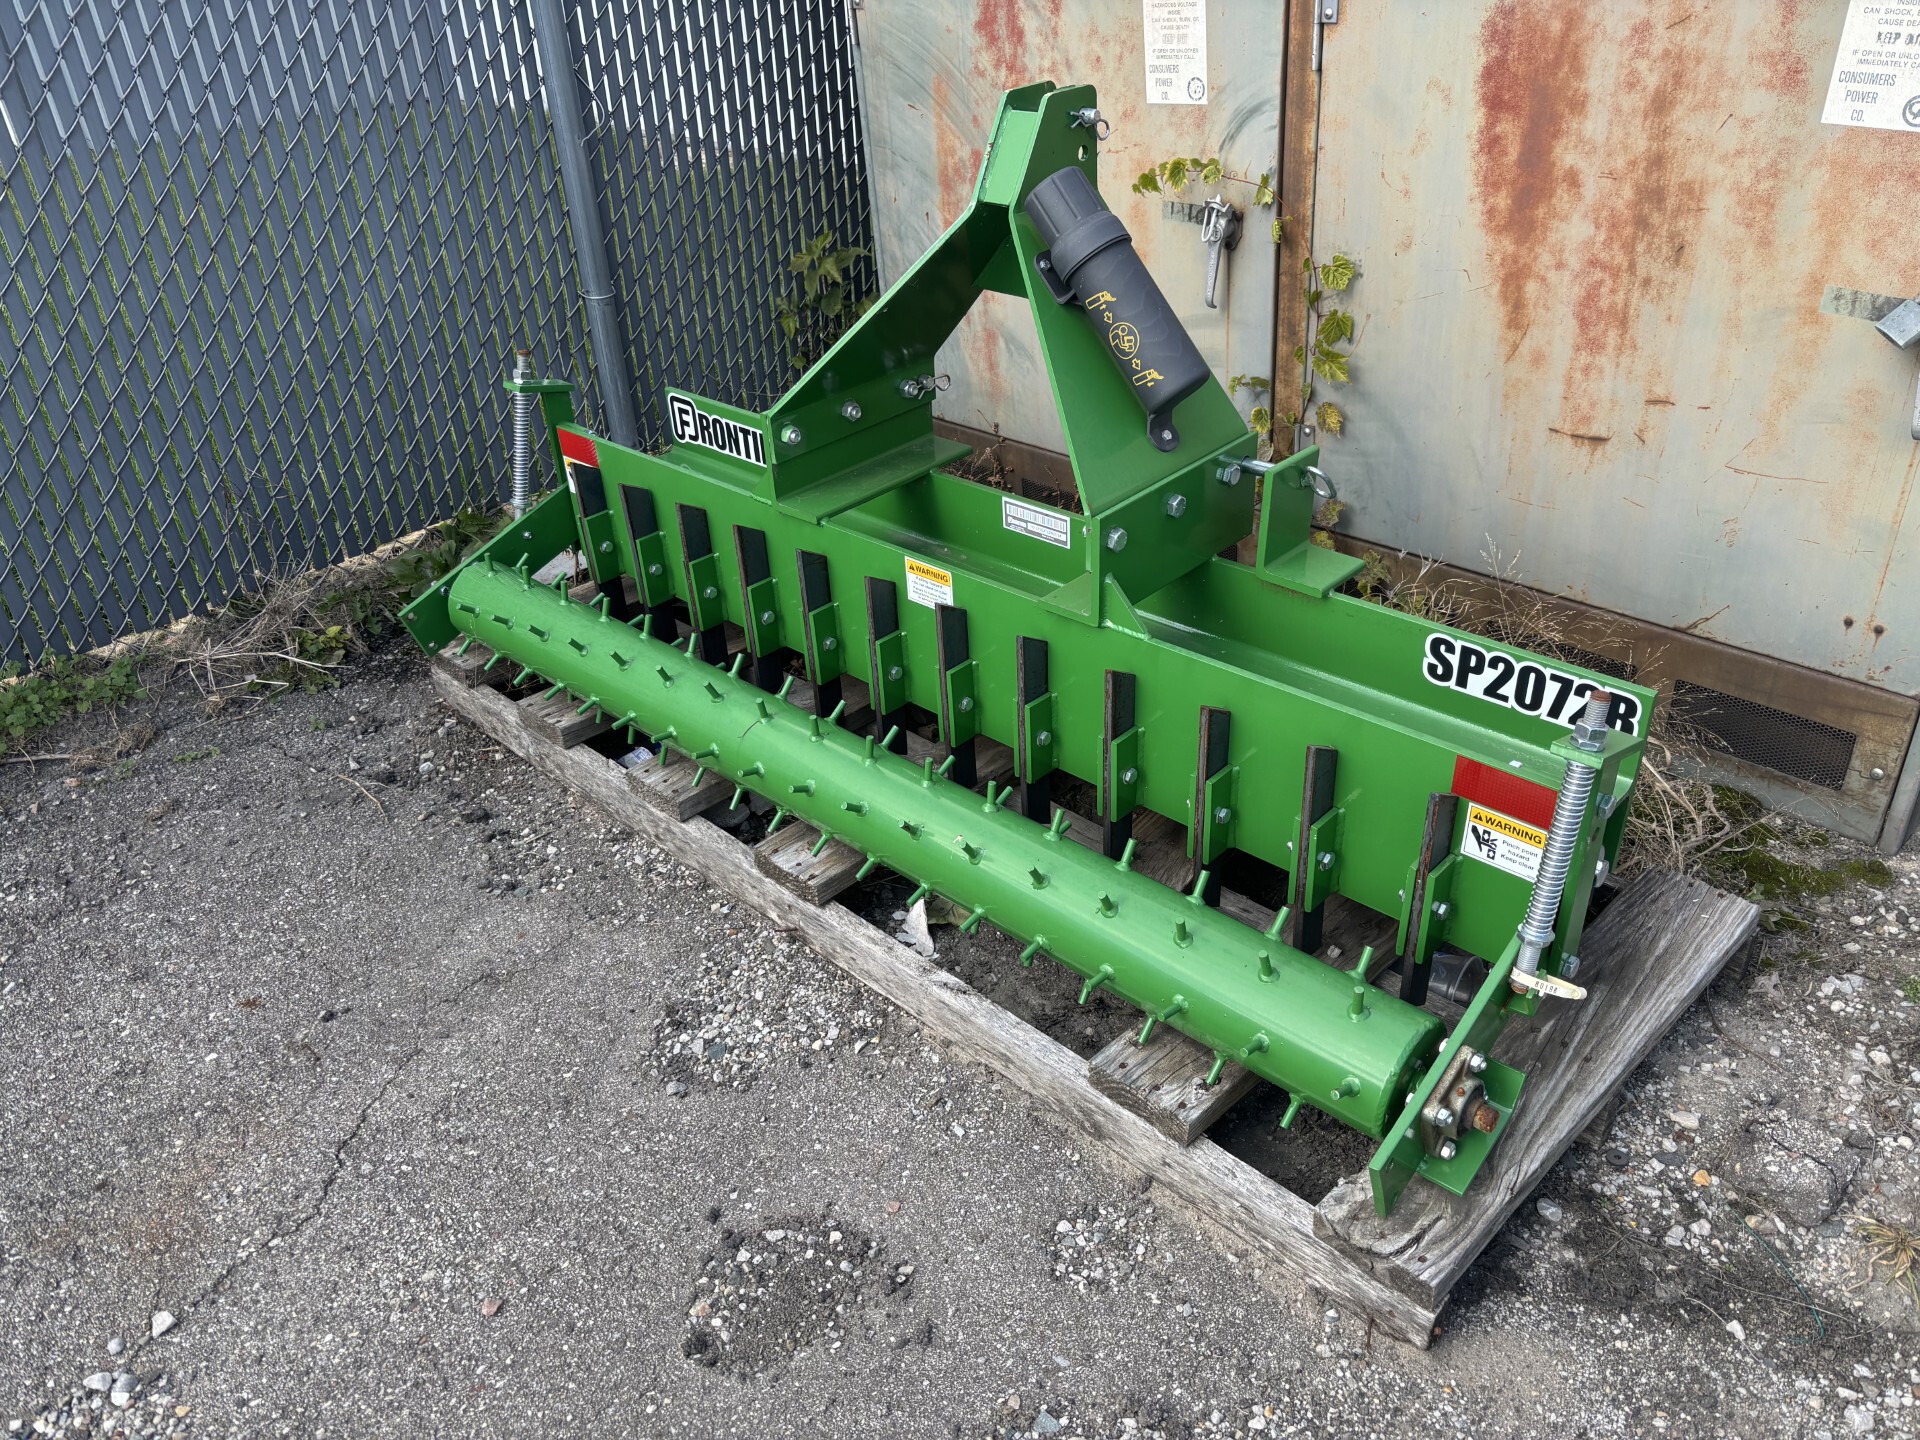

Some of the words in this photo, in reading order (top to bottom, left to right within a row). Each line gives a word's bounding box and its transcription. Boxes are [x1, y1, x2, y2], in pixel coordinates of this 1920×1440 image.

[1863, 6, 1880, 14] CAN
[1884, 8, 1914, 17] SHOCK,
[1878, 18, 1904, 26] CAUSE
[1149, 64, 1179, 73] CONSUMERS
[1857, 58, 1908, 68] IMMEDIATELY
[1155, 78, 1172, 87] POWER
[1838, 70, 1897, 86] CONSUMERS
[1161, 92, 1169, 100] CO.
[1845, 89, 1878, 104] POWER
[1851, 109, 1864, 122] CO.
[915, 565, 948, 583] WARNING
[1485, 815, 1542, 845] WARNING
[1502, 839, 1520, 851] Pinch
[1521, 849, 1538, 858] point
[1500, 853, 1517, 864] Keep
[1518, 861, 1534, 871] clear
[1508, 849, 1530, 862] hazard
